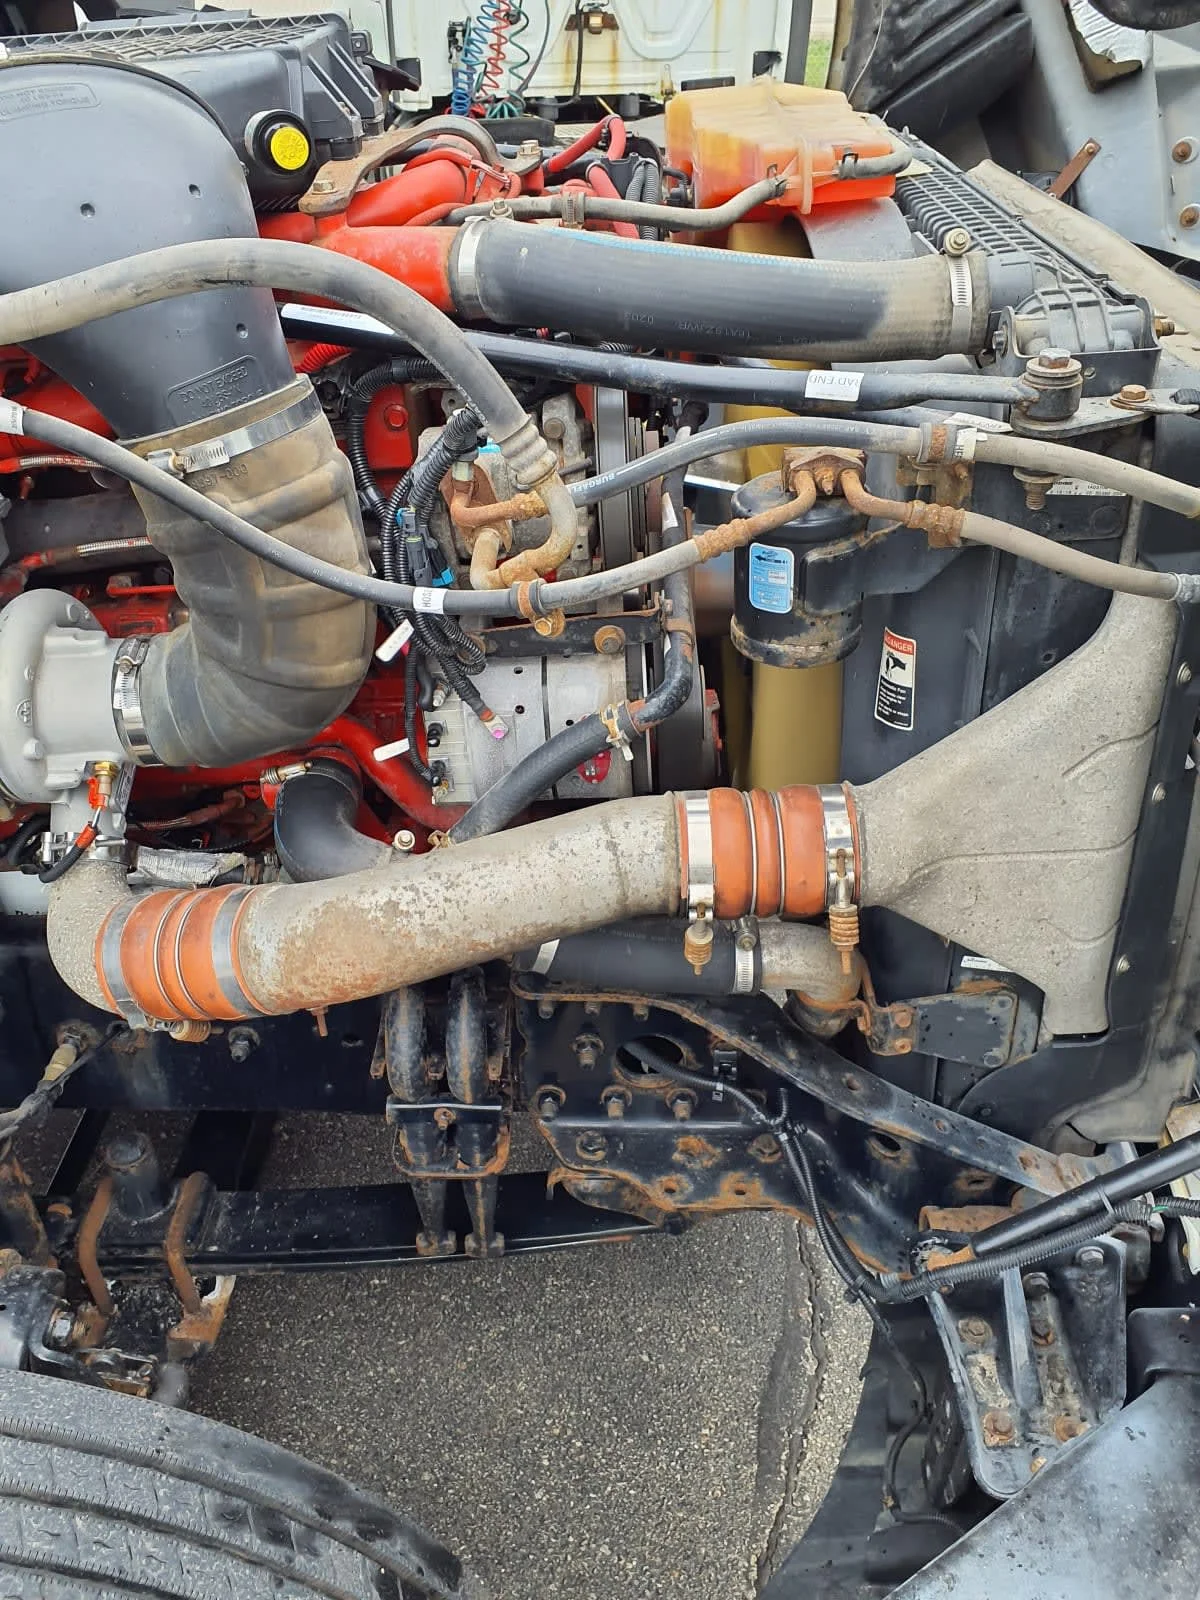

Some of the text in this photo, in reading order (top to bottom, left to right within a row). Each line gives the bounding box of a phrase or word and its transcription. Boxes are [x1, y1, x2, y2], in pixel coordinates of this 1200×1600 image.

[195, 380, 213, 394] NOT
[214, 366, 248, 388] EXCEED
[885, 633, 913, 654] DANGER
